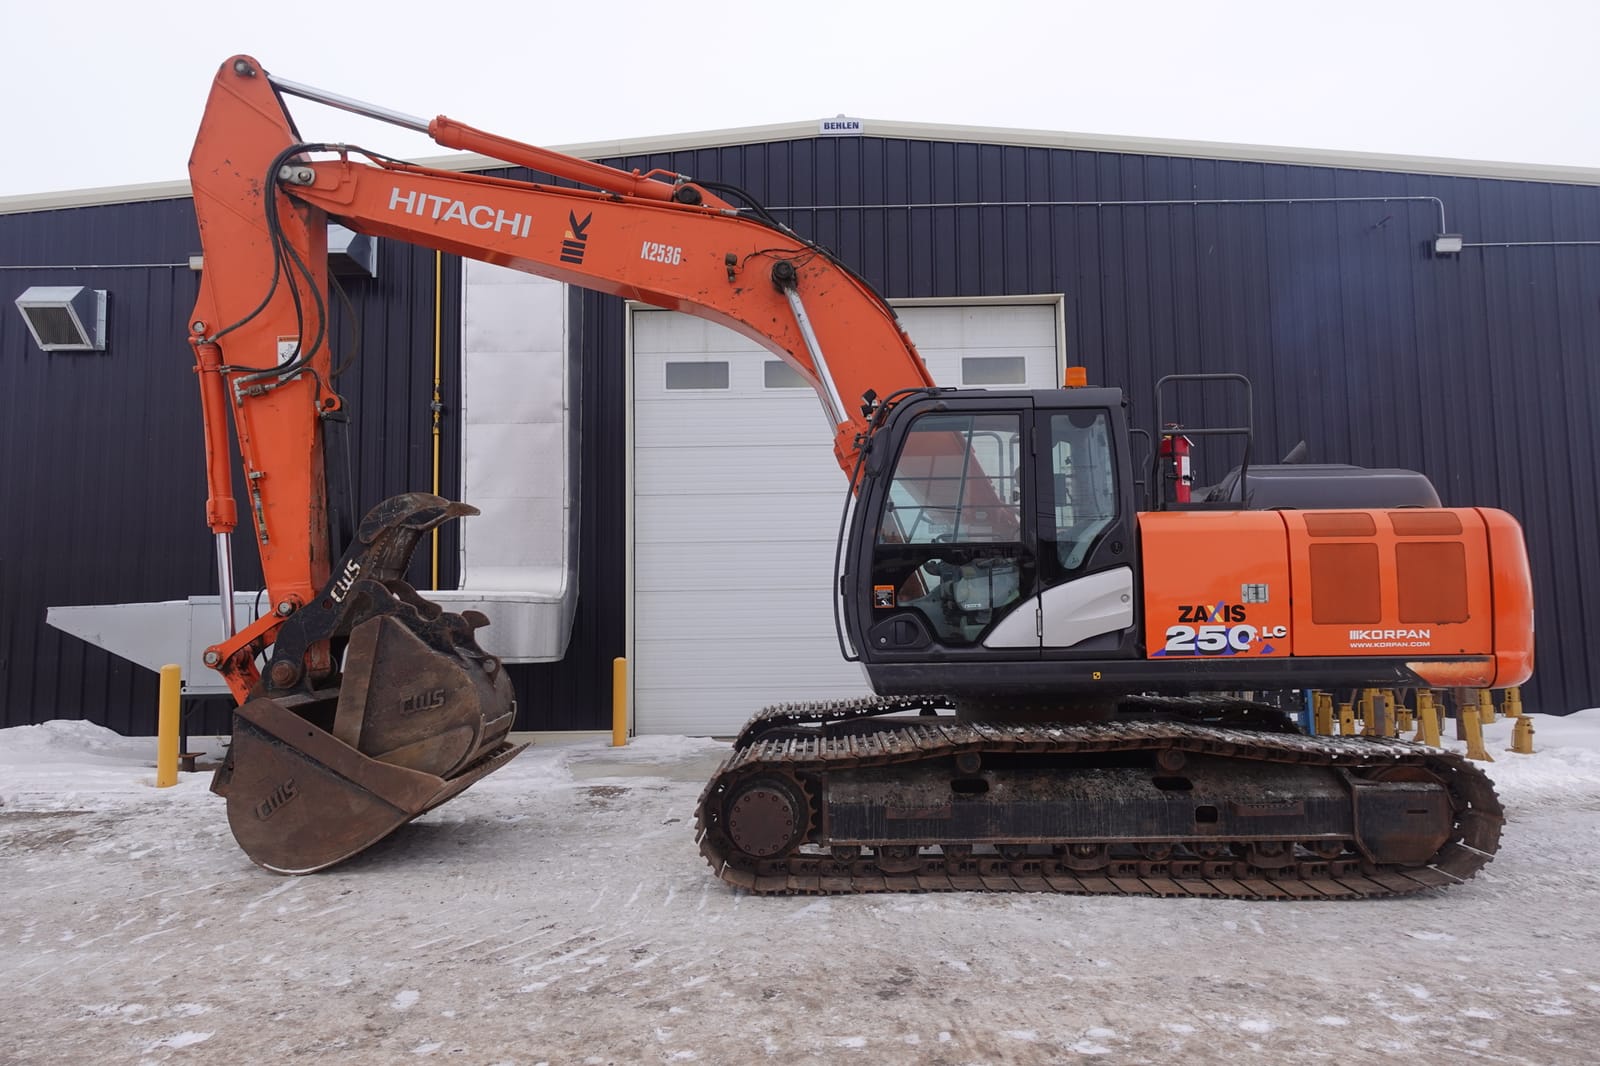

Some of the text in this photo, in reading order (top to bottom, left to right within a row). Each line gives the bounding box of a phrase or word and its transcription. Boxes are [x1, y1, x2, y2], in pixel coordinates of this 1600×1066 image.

[823, 121, 860, 130] BEHLEN
[388, 187, 533, 239] HITACHI
[640, 241, 682, 266] K2536
[1178, 601, 1247, 622] ZAXIS
[1165, 624, 1287, 655] 250 LC
[1358, 629, 1431, 640] KORPAN
